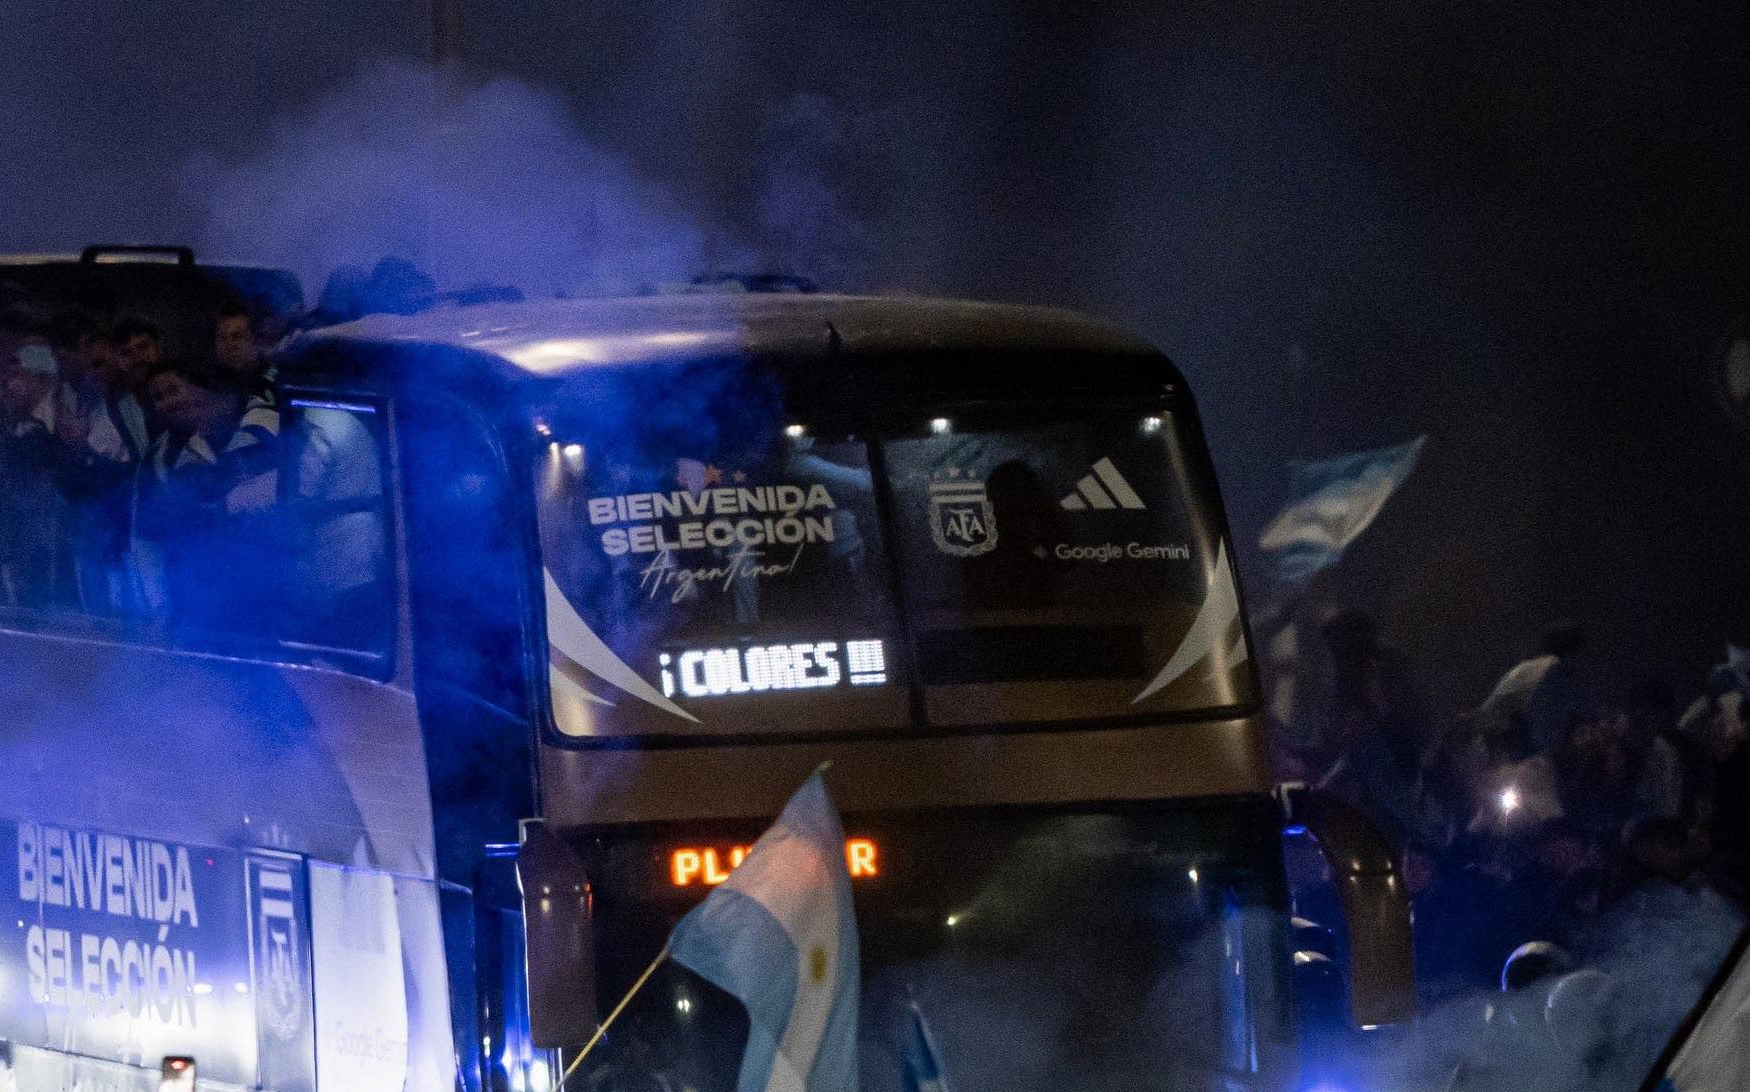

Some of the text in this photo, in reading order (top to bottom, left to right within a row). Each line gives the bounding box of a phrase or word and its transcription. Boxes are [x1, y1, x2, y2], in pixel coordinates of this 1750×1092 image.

[588, 484, 836, 525] BIENVENIDA
[1055, 542, 1190, 563] Google Gemini
[18, 822, 198, 928] BIENVENIDA
[27, 924, 198, 1029] SELECCIÓN
